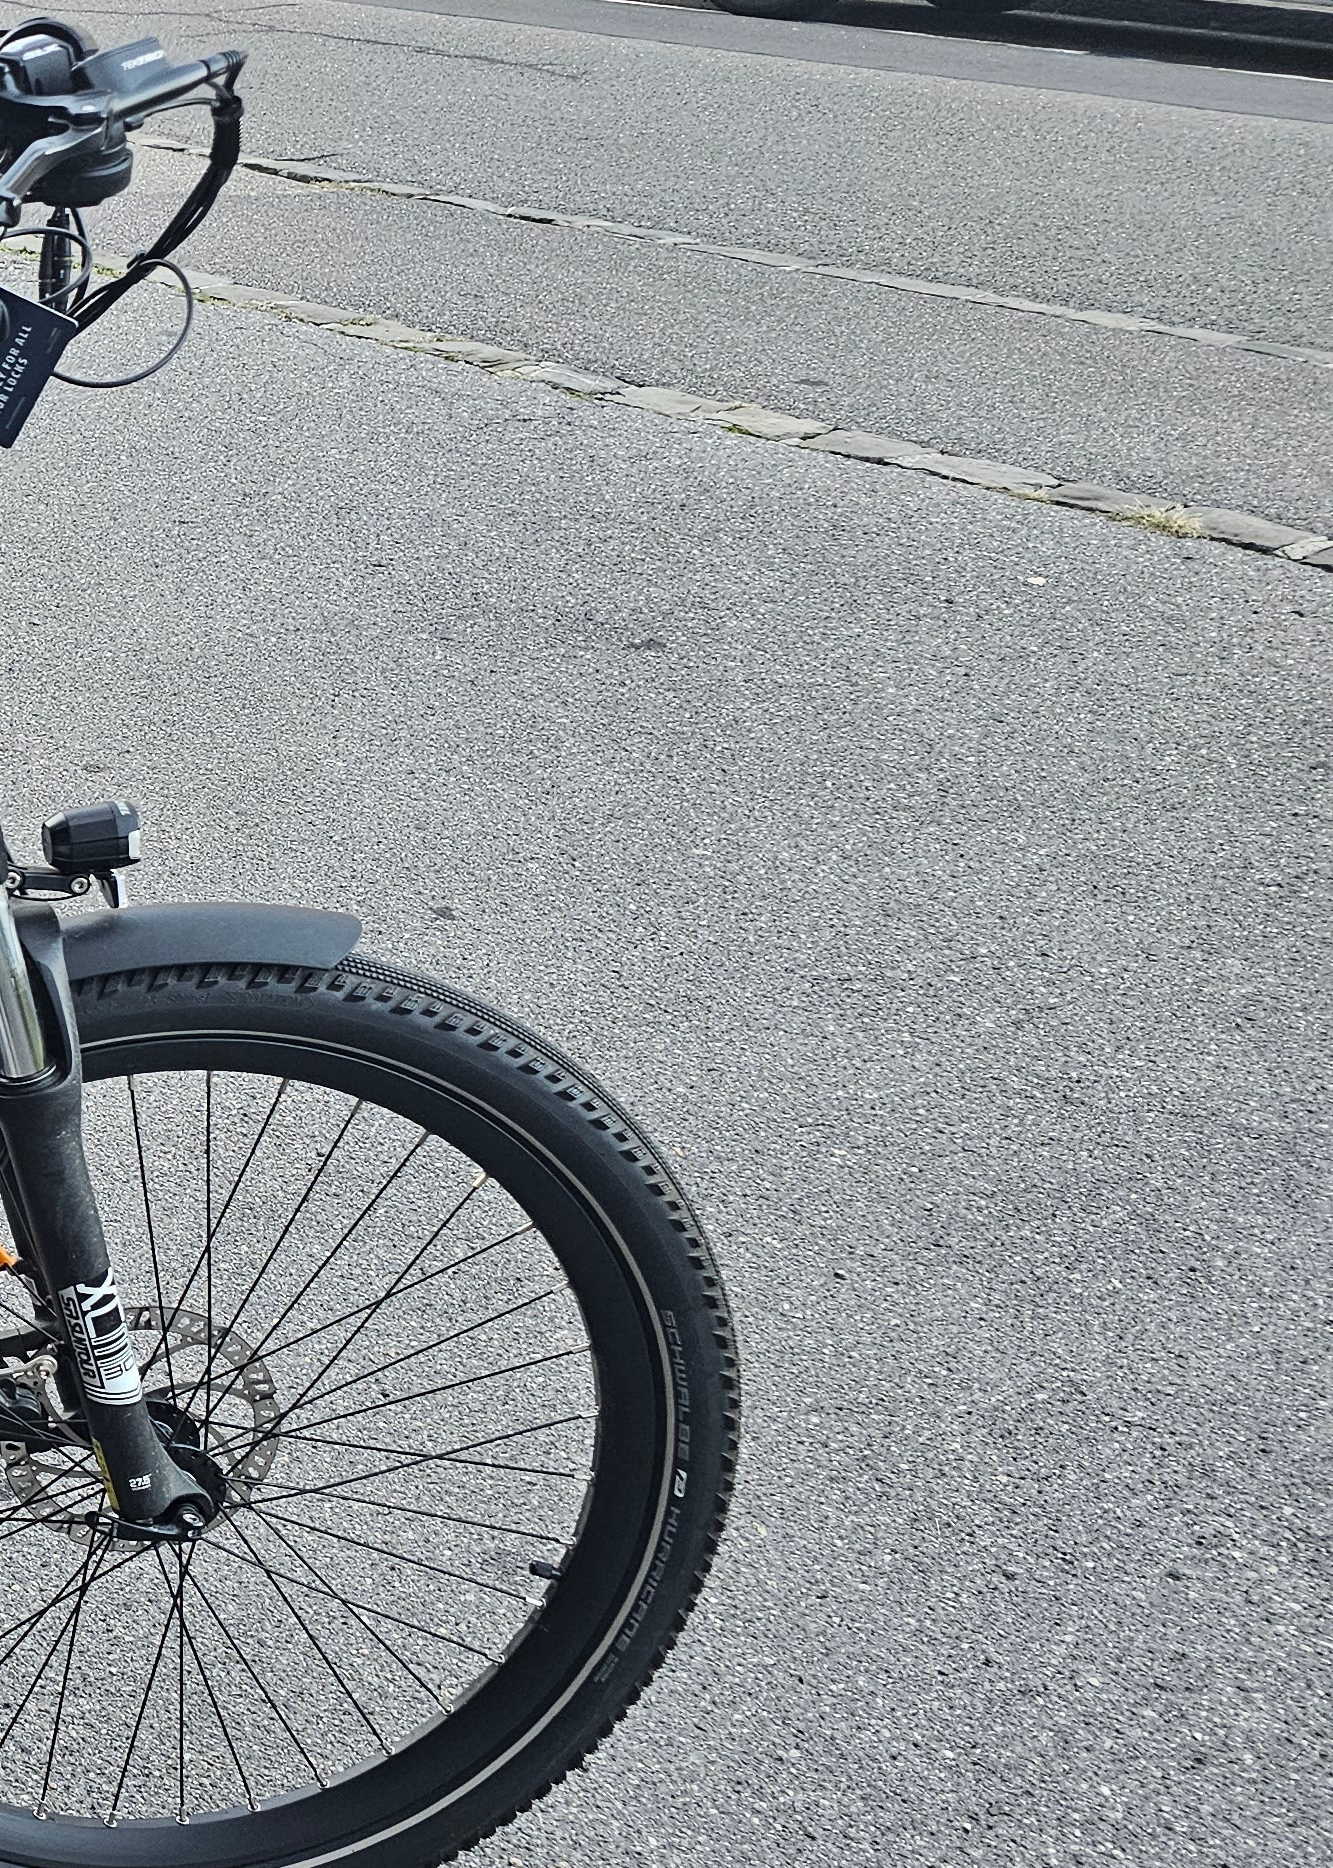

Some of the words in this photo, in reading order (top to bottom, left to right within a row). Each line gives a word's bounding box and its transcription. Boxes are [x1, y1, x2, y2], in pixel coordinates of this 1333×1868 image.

[1, 347, 20, 370] FOR
[14, 325, 33, 346] ALL
[7, 357, 28, 392] LOCKS
[660, 1309, 691, 1462] SCHWALBE
[614, 1505, 681, 1652] HURRICANE
